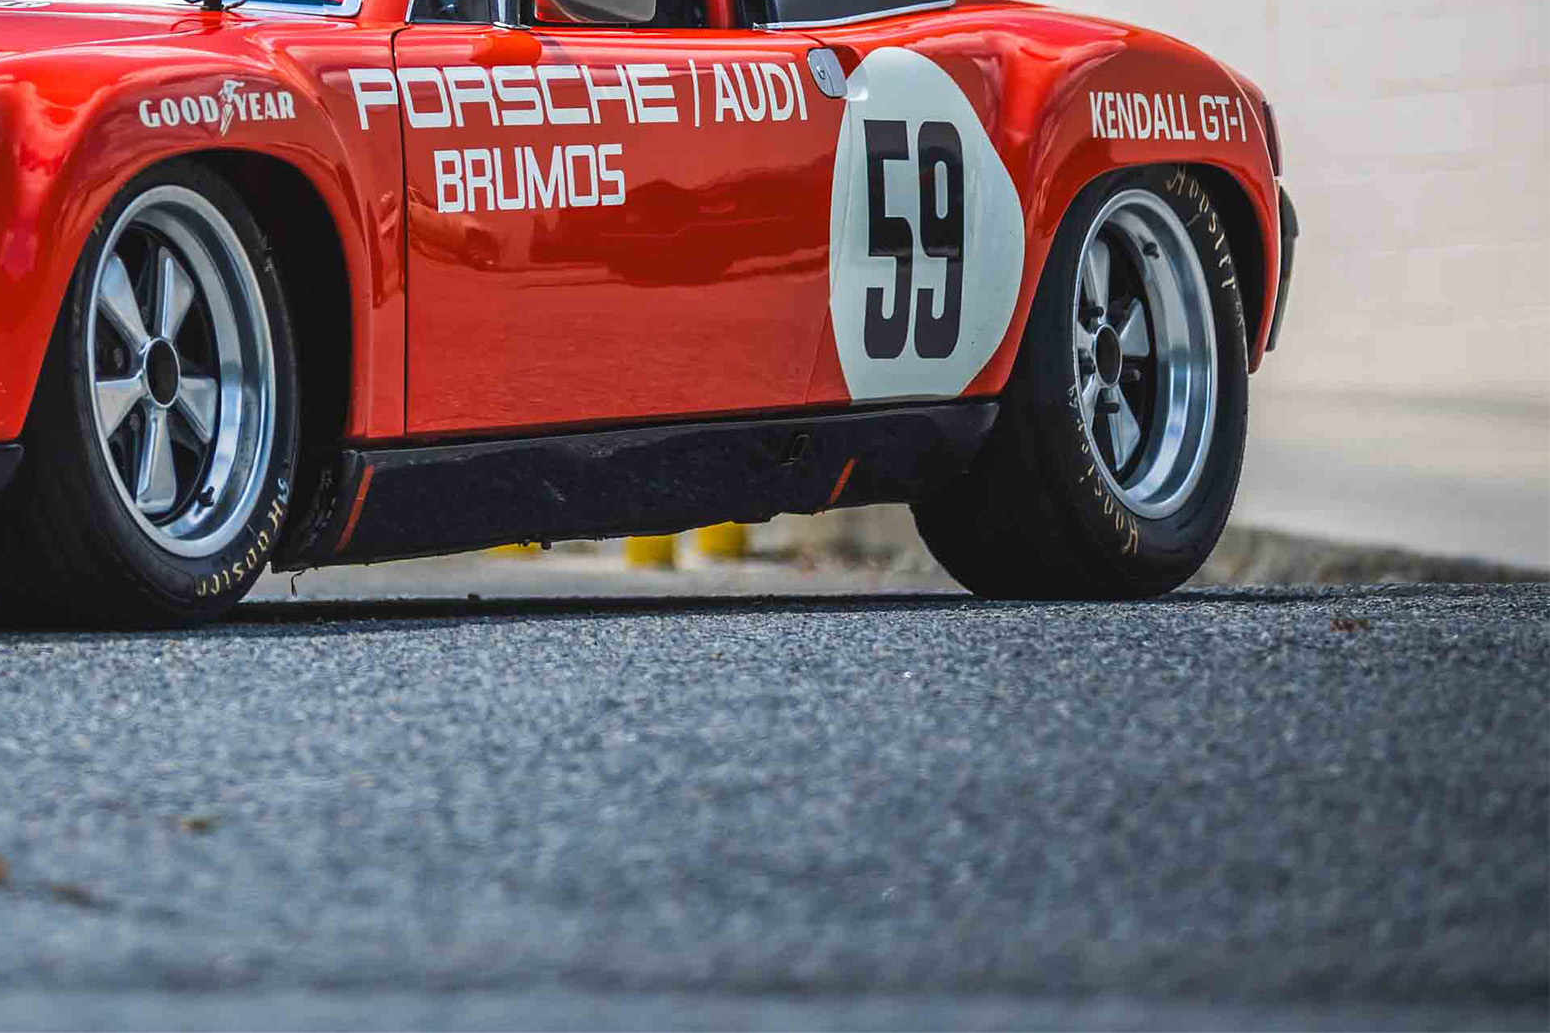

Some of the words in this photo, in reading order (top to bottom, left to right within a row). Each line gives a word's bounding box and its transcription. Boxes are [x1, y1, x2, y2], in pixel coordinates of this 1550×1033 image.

[348, 63, 678, 131] PORSCHE
[1088, 91, 1197, 141] KENDALL
[1198, 94, 1248, 143] GT-1
[433, 143, 626, 214] BRUMOS
[863, 119, 965, 360] 59
